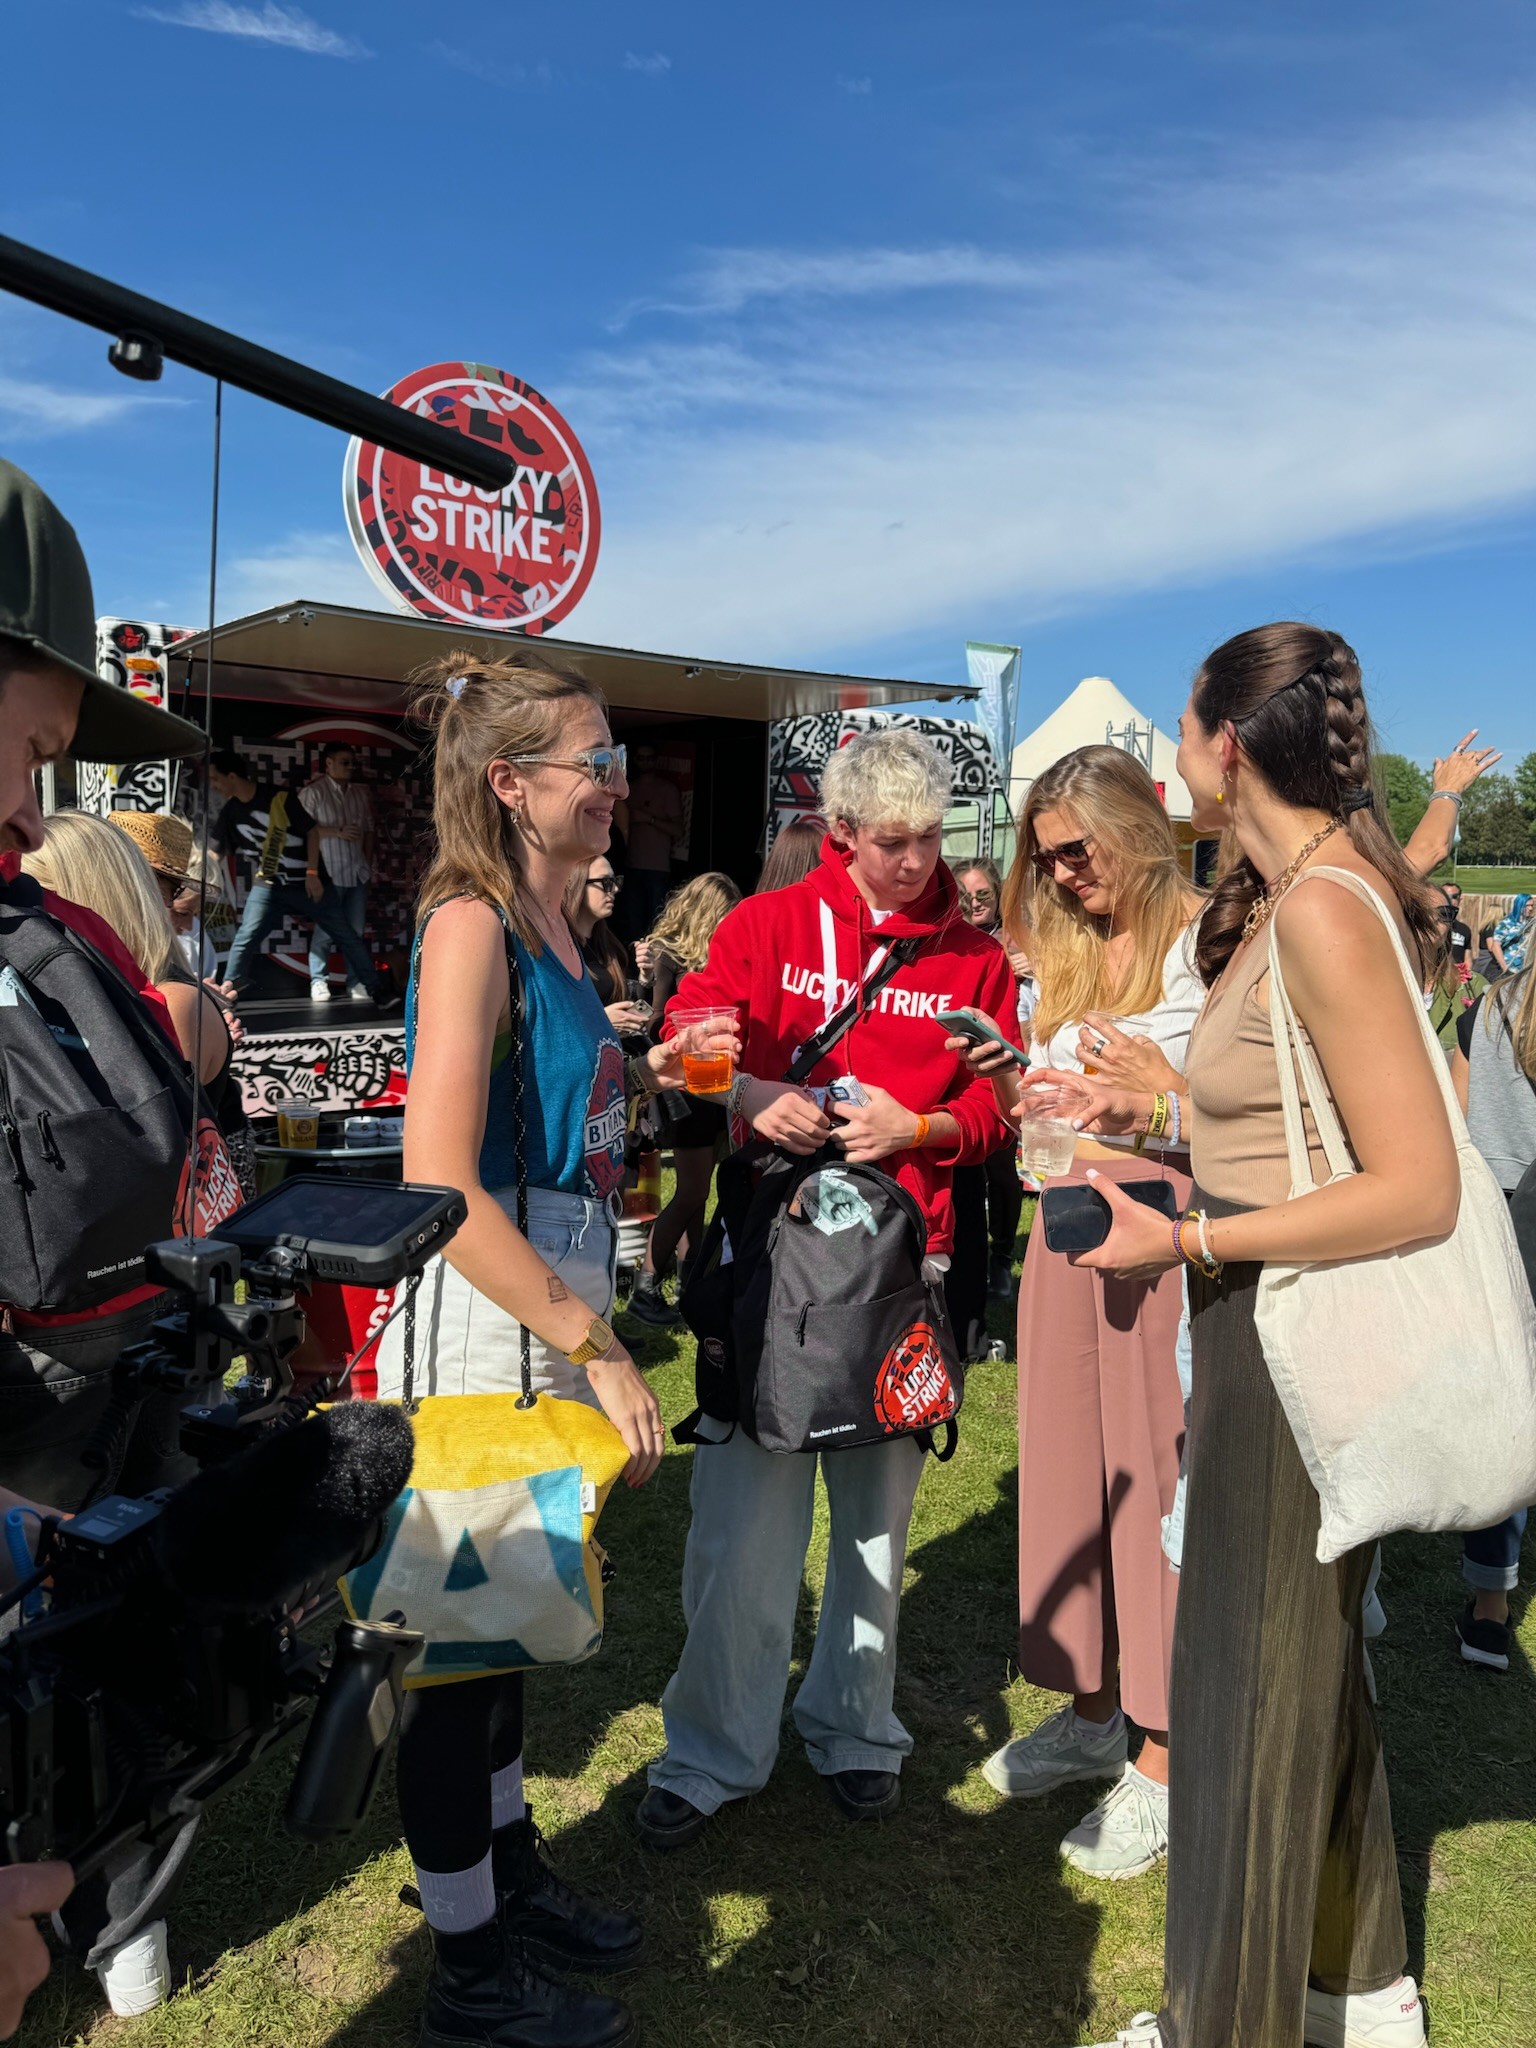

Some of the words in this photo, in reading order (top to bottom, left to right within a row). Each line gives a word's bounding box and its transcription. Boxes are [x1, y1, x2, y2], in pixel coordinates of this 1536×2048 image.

[411, 495, 553, 571] STRIKE
[781, 962, 860, 1007] LUCY
[865, 987, 953, 1019] TRIKE
[197, 1144, 229, 1221] LUCKY
[87, 1264, 117, 1280] Rauchen
[117, 1260, 127, 1270] ist
[126, 1255, 146, 1267] tödlic
[894, 1346, 935, 1406] LUCKY
[902, 1363, 947, 1422] STRIKE
[809, 1428, 832, 1439] Rauchen
